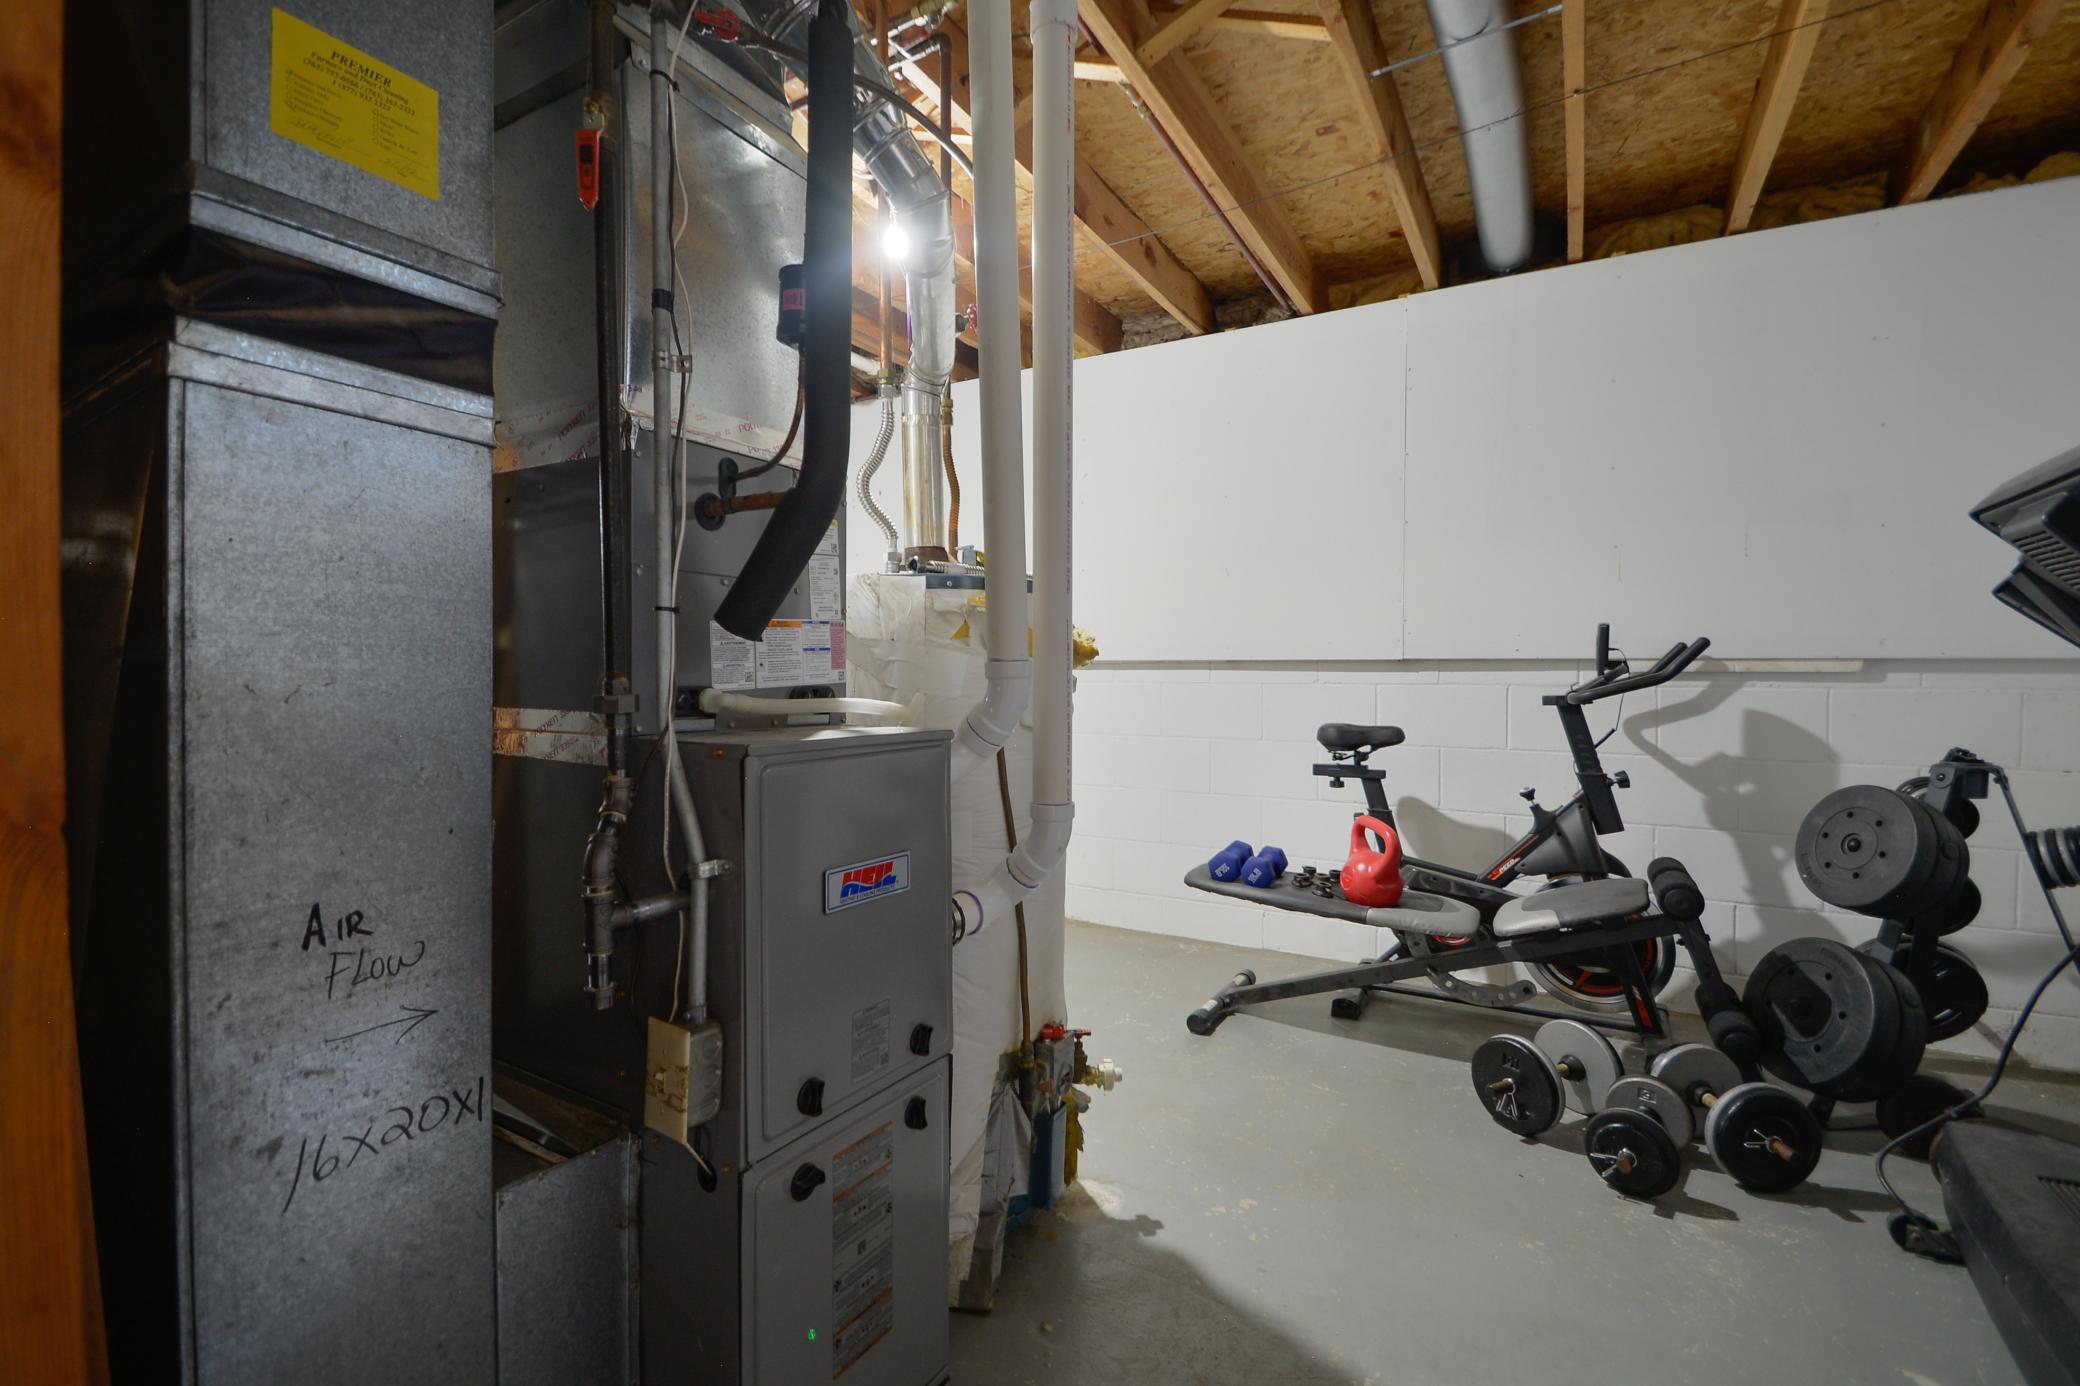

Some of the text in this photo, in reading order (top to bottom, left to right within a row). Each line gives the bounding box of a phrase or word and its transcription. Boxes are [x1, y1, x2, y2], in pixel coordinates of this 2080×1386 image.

[331, 50, 392, 88] PREMIER
[840, 861, 897, 898] HEIL
[301, 902, 374, 951] AIR
